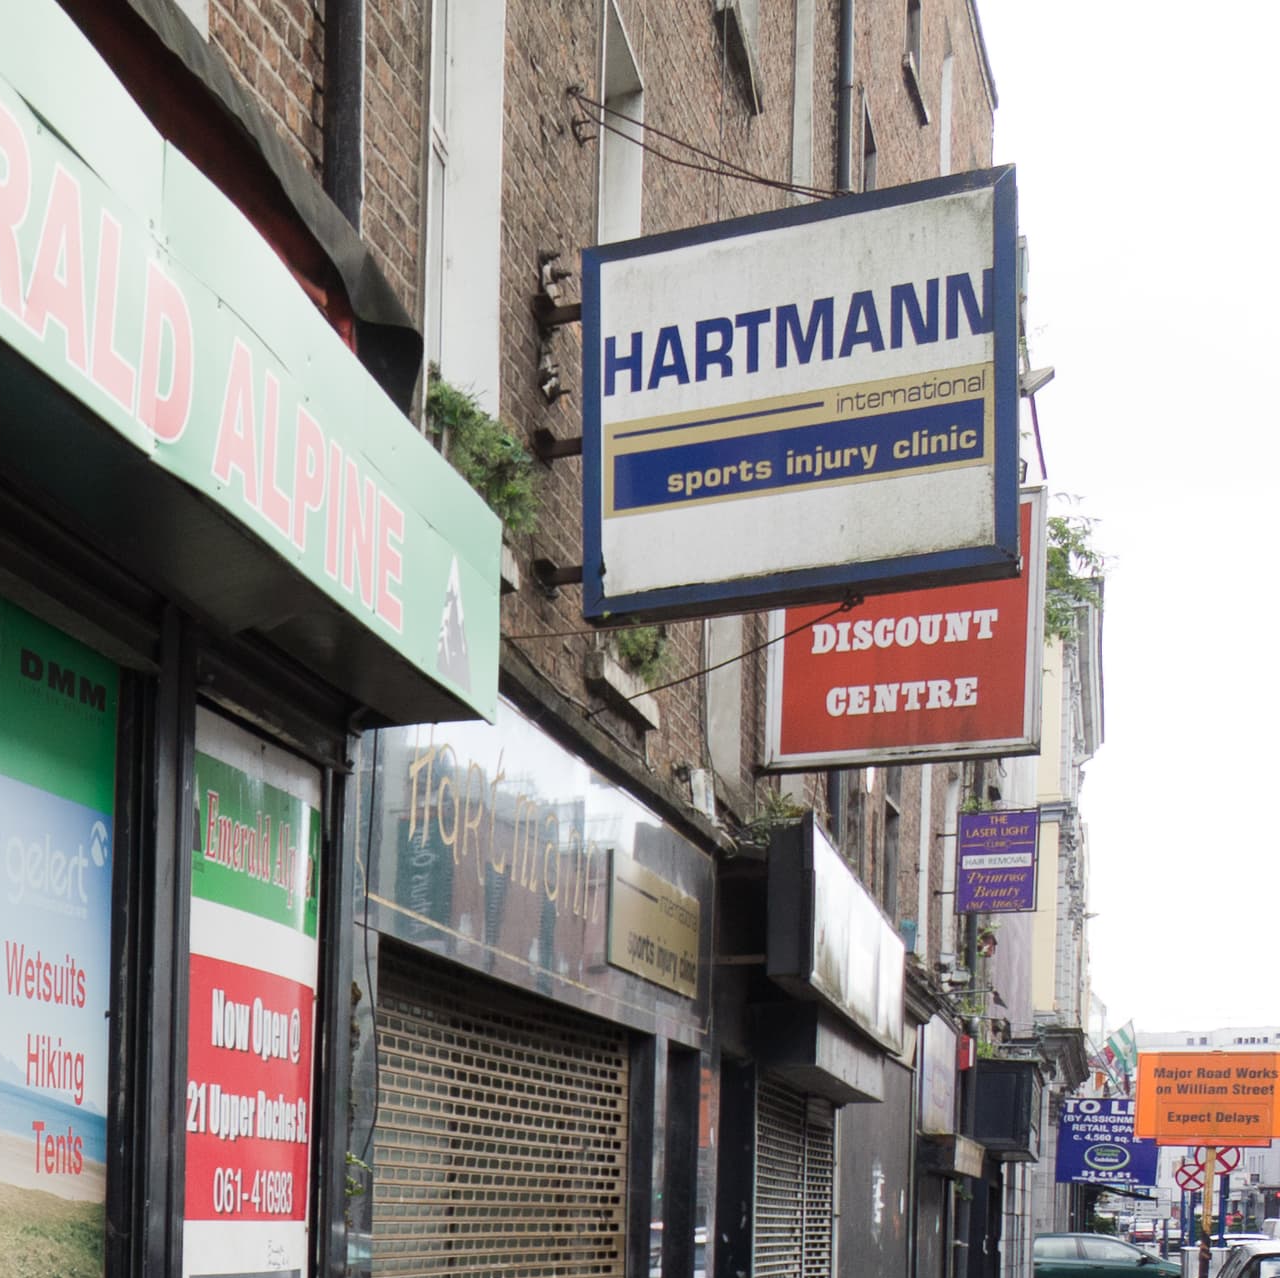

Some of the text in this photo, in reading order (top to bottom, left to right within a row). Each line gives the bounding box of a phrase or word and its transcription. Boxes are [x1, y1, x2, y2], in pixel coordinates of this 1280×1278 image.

[604, 267, 994, 398] HARTMANN
[836, 368, 986, 414] international
[667, 423, 978, 497] sports injury clinic
[211, 335, 405, 635] ALPINE
[811, 609, 999, 655] DISCOUNT
[21, 647, 107, 713] DMM
[826, 676, 979, 718] CENTRE
[204, 789, 272, 885] Emerald
[966, 825, 1030, 838] LASER LIGHT
[989, 814, 1009, 825] THE
[973, 885, 1021, 899] Beauty
[5, 940, 87, 1010] Wetsuits
[211, 987, 301, 1065] Now Open @
[26, 1033, 85, 1106] Hiking
[1154, 1067, 1279, 1081] Major Road Works
[1156, 1083, 1275, 1096] on William Street
[186, 1080, 207, 1133] 21
[209, 1083, 256, 1142] Upper
[257, 1089, 297, 1143] Roches
[1064, 1099, 1101, 1114] TO
[1167, 1111, 1260, 1125] Expect Delays
[32, 1121, 84, 1176] Tents
[213, 1167, 294, 1215] 061-416983
